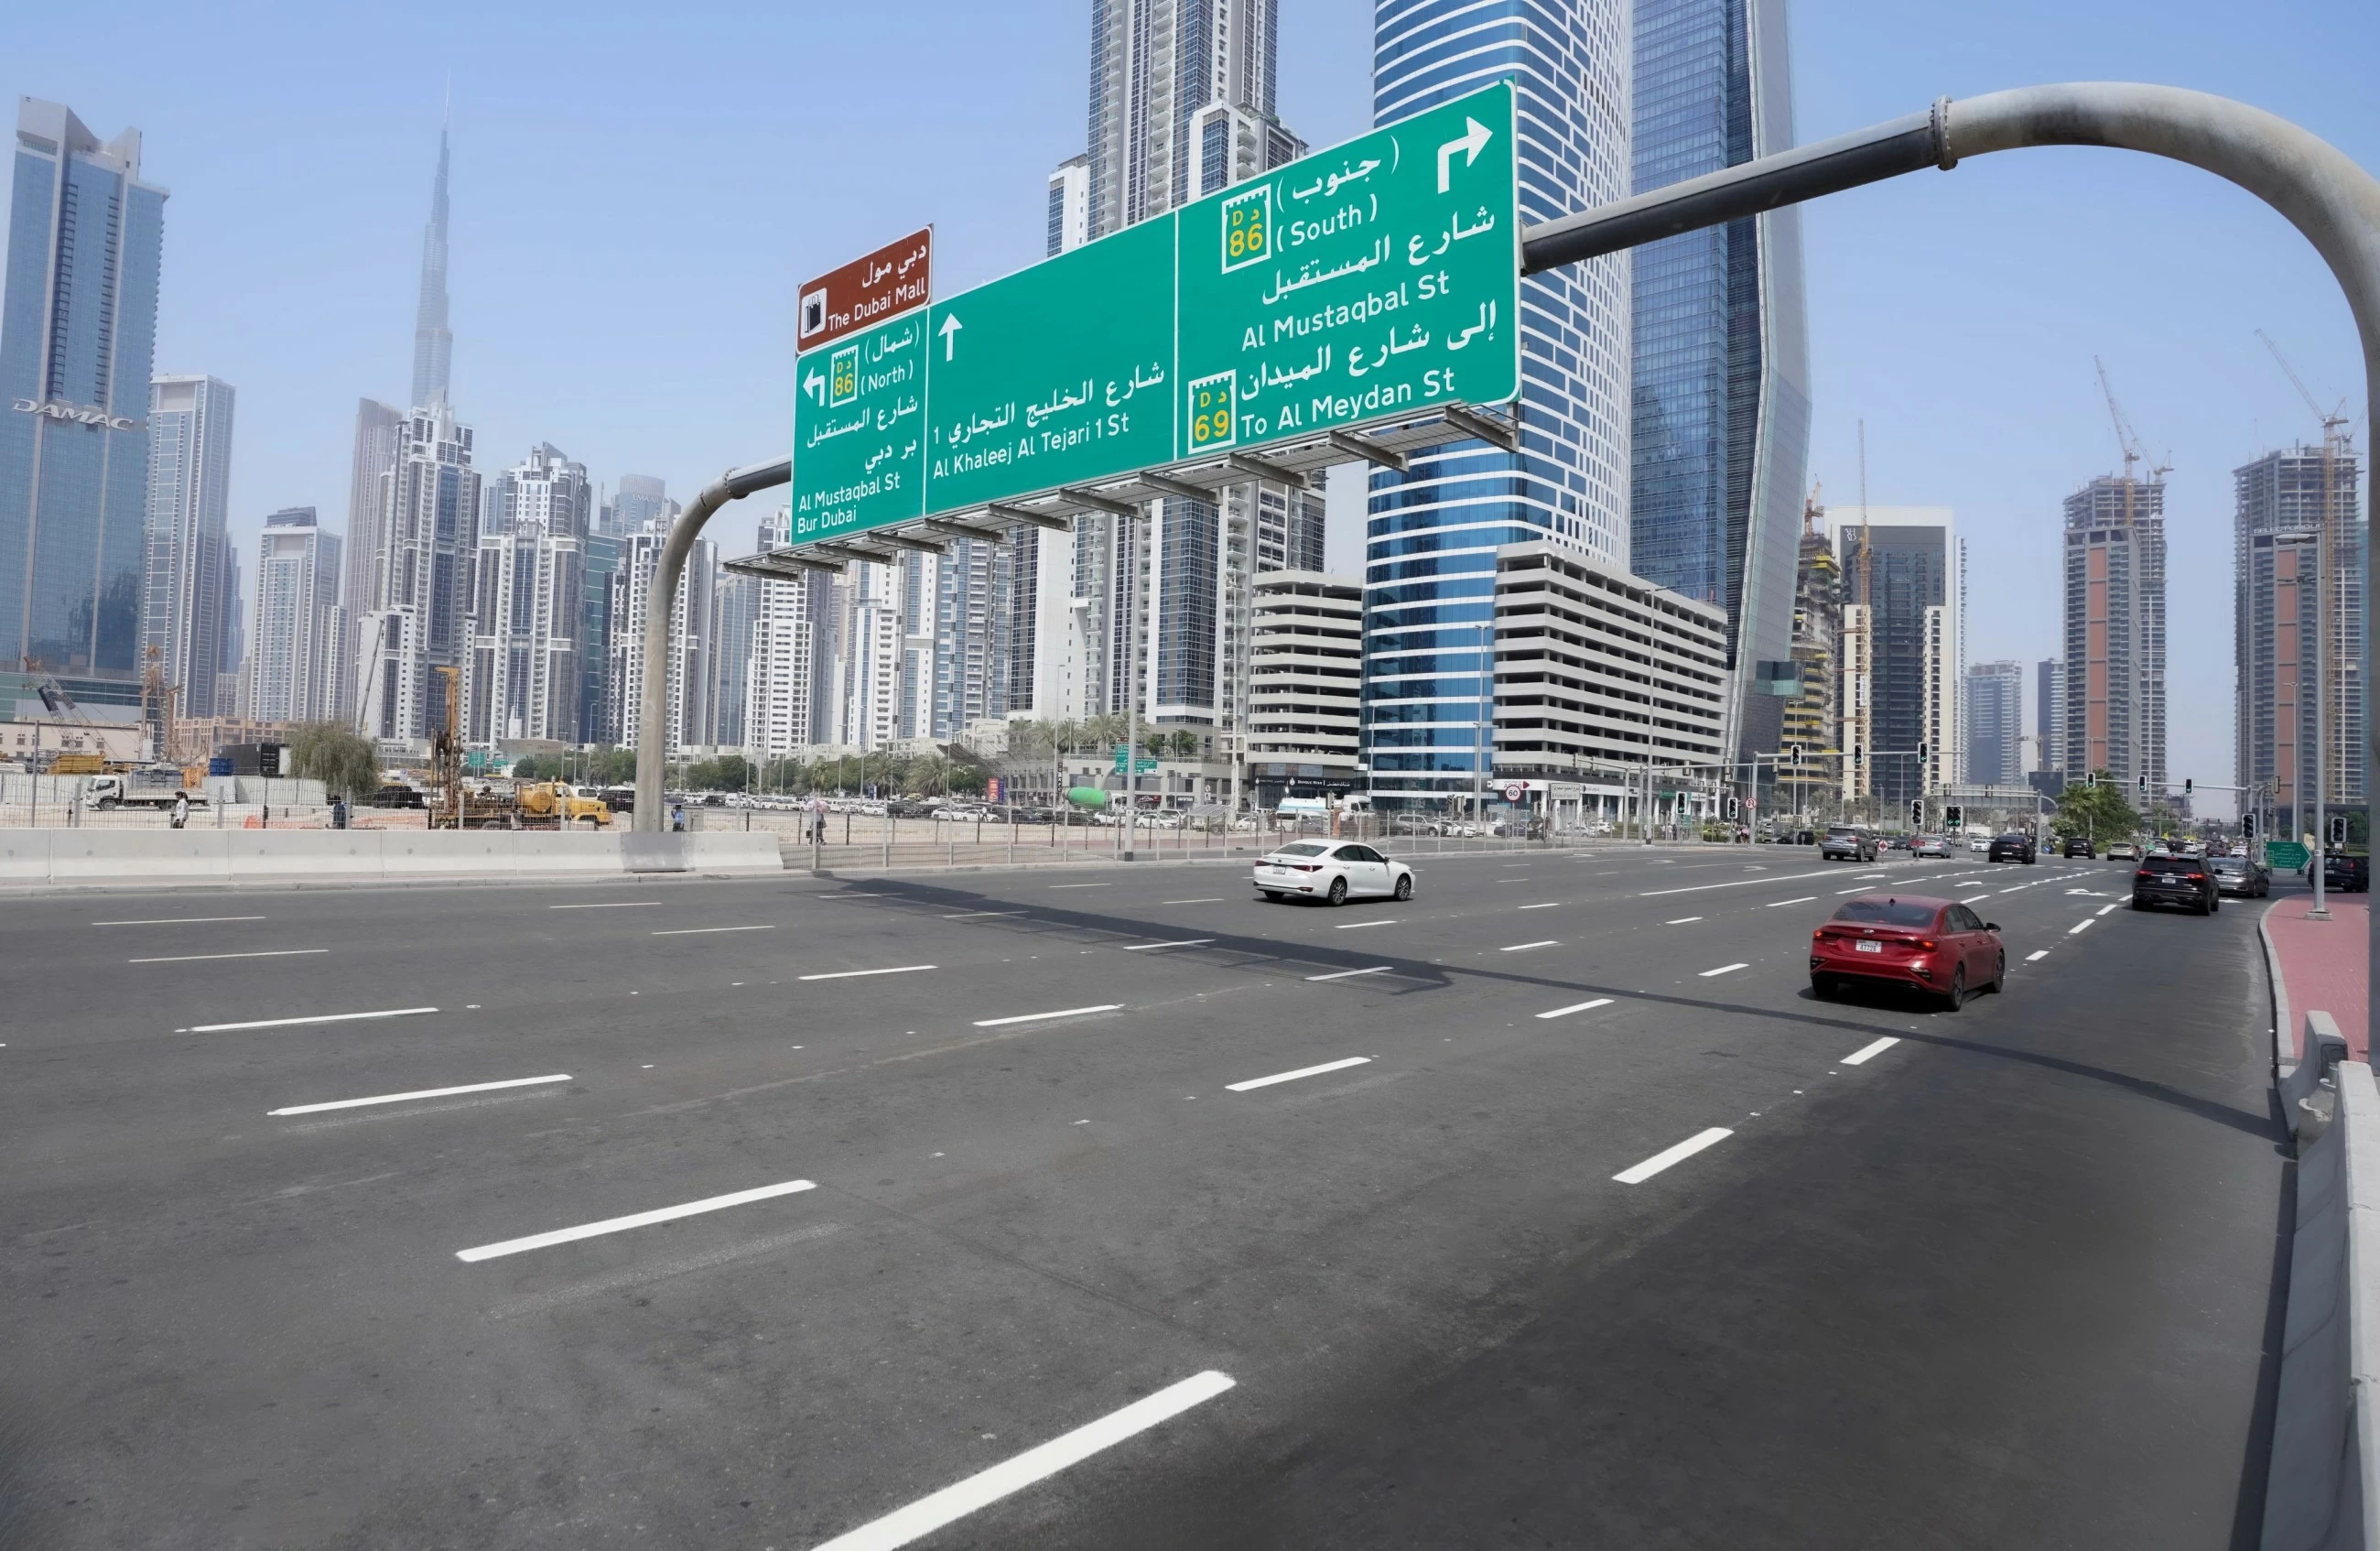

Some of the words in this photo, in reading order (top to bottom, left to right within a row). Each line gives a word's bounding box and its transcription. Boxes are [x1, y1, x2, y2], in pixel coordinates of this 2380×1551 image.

[1232, 211, 1243, 227] D
[1408, 205, 1495, 266] شارع
[1229, 223, 1263, 257] 86
[861, 261, 892, 287] مول
[898, 244, 926, 278] دبي
[1262, 233, 1390, 305] المستقبل
[828, 310, 849, 332] The
[855, 291, 891, 320] Dubai
[895, 279, 925, 302] Mall
[1241, 327, 1266, 352] Al
[1273, 282, 1409, 342] Mustaqbal
[1418, 270, 1450, 300] St
[1446, 298, 1497, 351] إلى
[1348, 323, 1430, 374] شارع
[835, 375, 854, 396] 86
[1105, 361, 1164, 406] شارع
[1241, 344, 1331, 401] الميدان
[13, 398, 134, 430] DAMAC
[877, 394, 917, 431] شارع
[1026, 378, 1093, 428] الخليج
[1200, 392, 1210, 407] D
[1240, 415, 1267, 439] To
[1278, 406, 1303, 430] Al
[1312, 384, 1412, 423] Meydan
[1423, 367, 1455, 397] St
[806, 407, 870, 449] المستقبل
[935, 426, 939, 444] 1
[948, 402, 1015, 449] التجاري
[1195, 409, 1229, 441] 69
[865, 444, 892, 473] دبي
[901, 438, 916, 460] بر
[933, 460, 949, 480] Al
[954, 443, 1012, 475] Khaleej
[1018, 438, 1035, 458] Al
[1041, 419, 1089, 453] Tejari
[1097, 418, 1102, 438] 1
[1108, 413, 1130, 435] St
[633, 494, 659, 504] EMAAR
[798, 492, 811, 512] Al
[815, 482, 881, 507] Mustaqbal
[885, 472, 900, 490] St
[797, 517, 816, 533] Bur
[821, 507, 856, 528] Dubai
